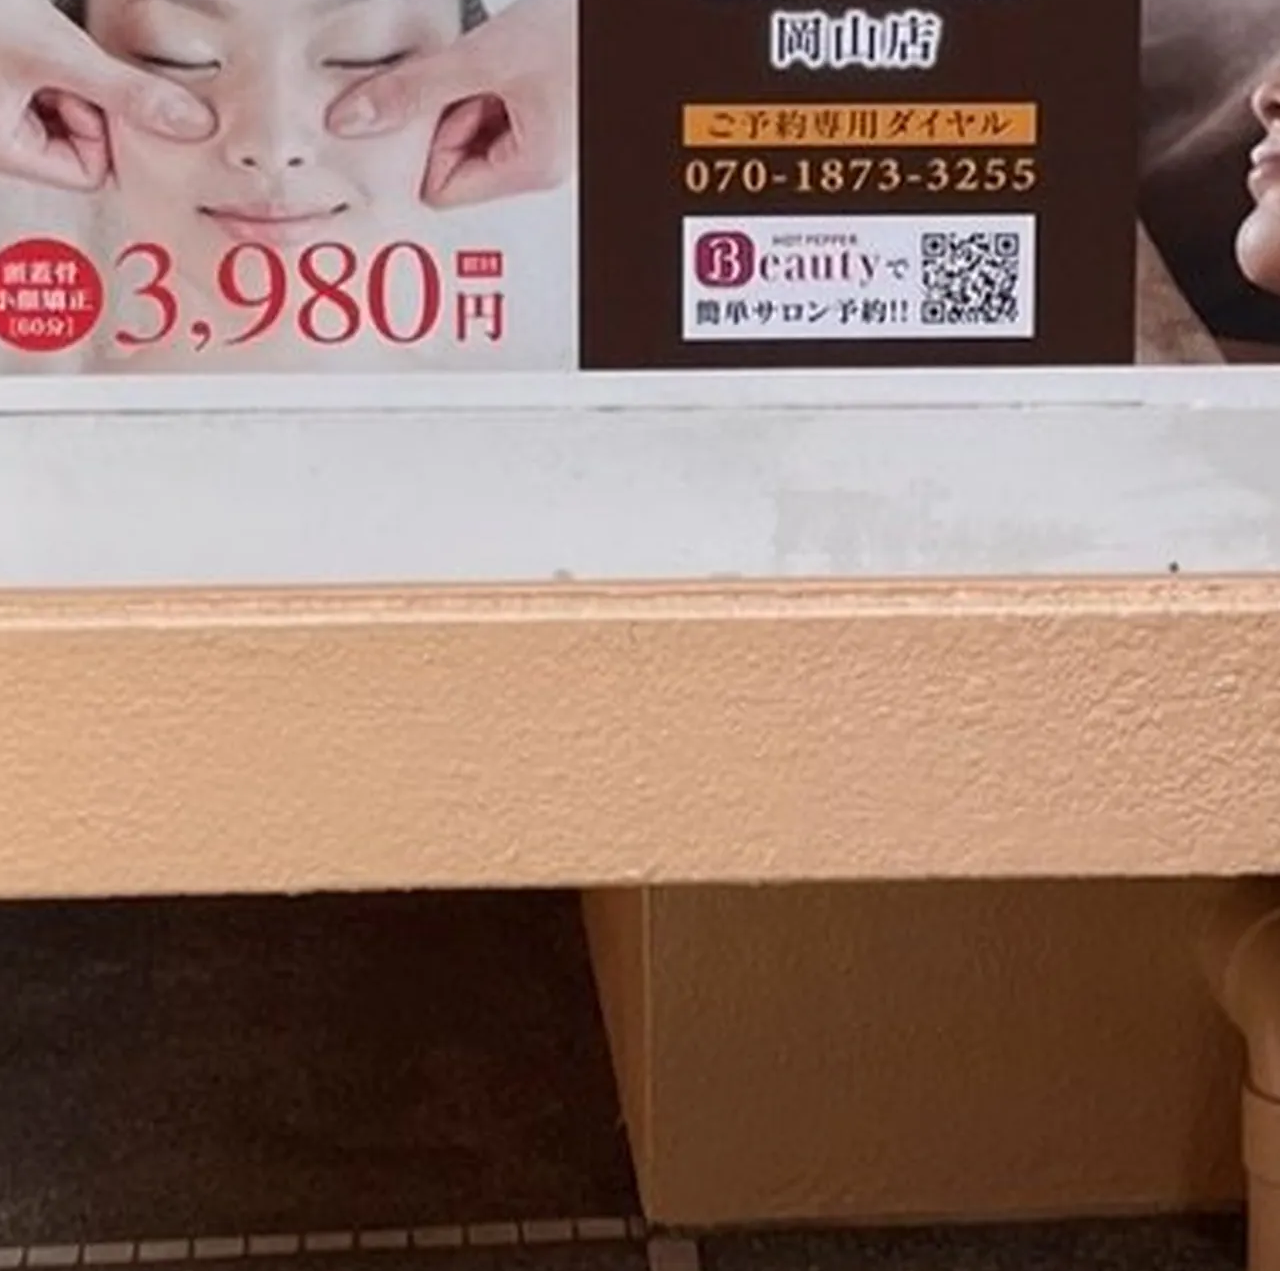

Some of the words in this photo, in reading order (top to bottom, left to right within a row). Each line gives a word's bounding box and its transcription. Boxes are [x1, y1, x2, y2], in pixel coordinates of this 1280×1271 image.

[773, 12, 939, 66] 岡山店
[706, 108, 1014, 140] ご予約専用ダイヤル
[684, 157, 1037, 192] 070-1873-3255
